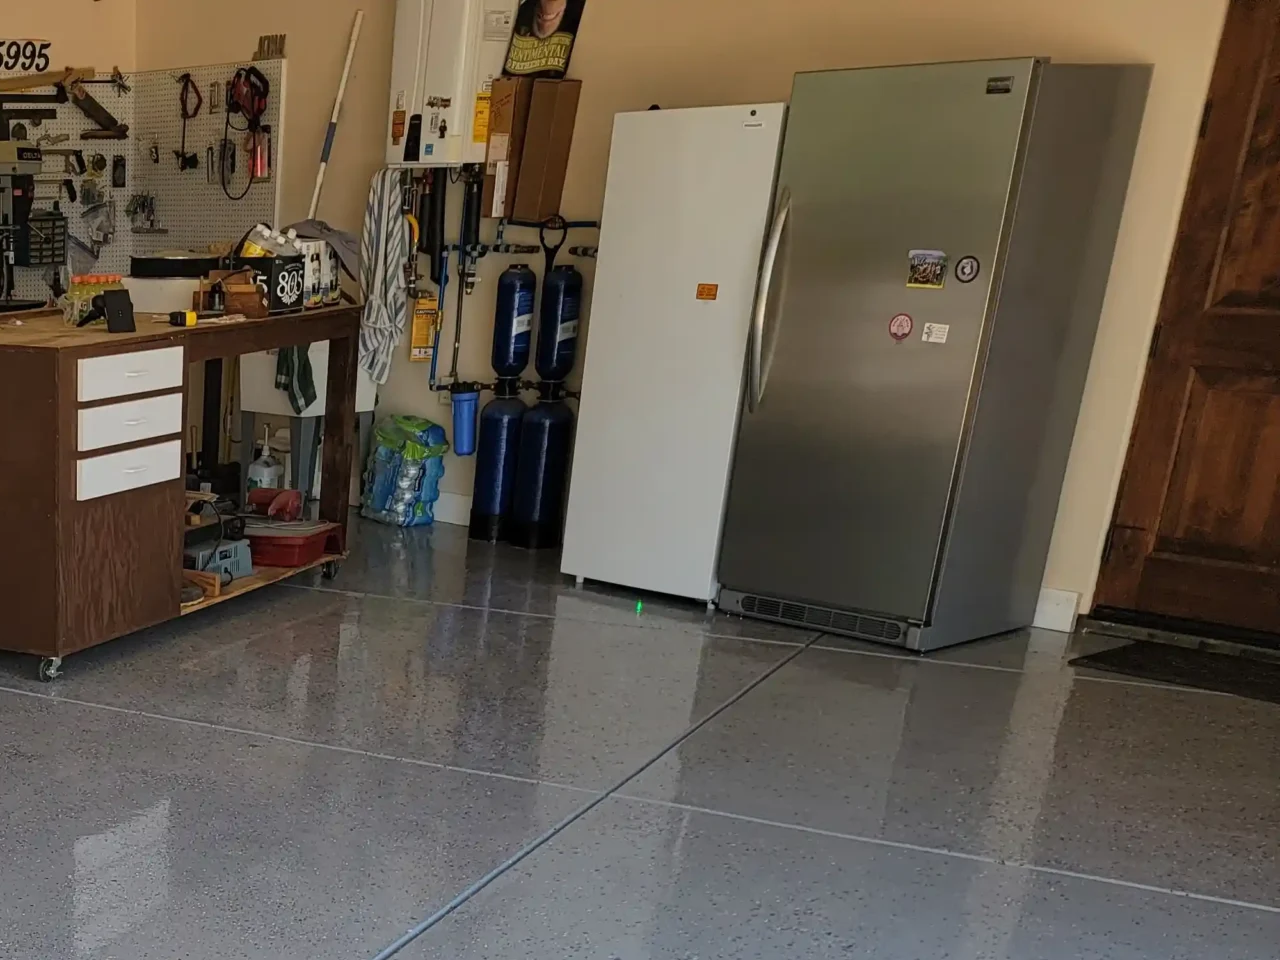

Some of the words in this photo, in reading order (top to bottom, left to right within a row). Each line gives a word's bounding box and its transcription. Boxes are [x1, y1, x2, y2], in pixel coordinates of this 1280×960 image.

[510, 43, 566, 61] SENTIMENTAL
[547, 57, 566, 67] DAY
[276, 270, 303, 297] 805
